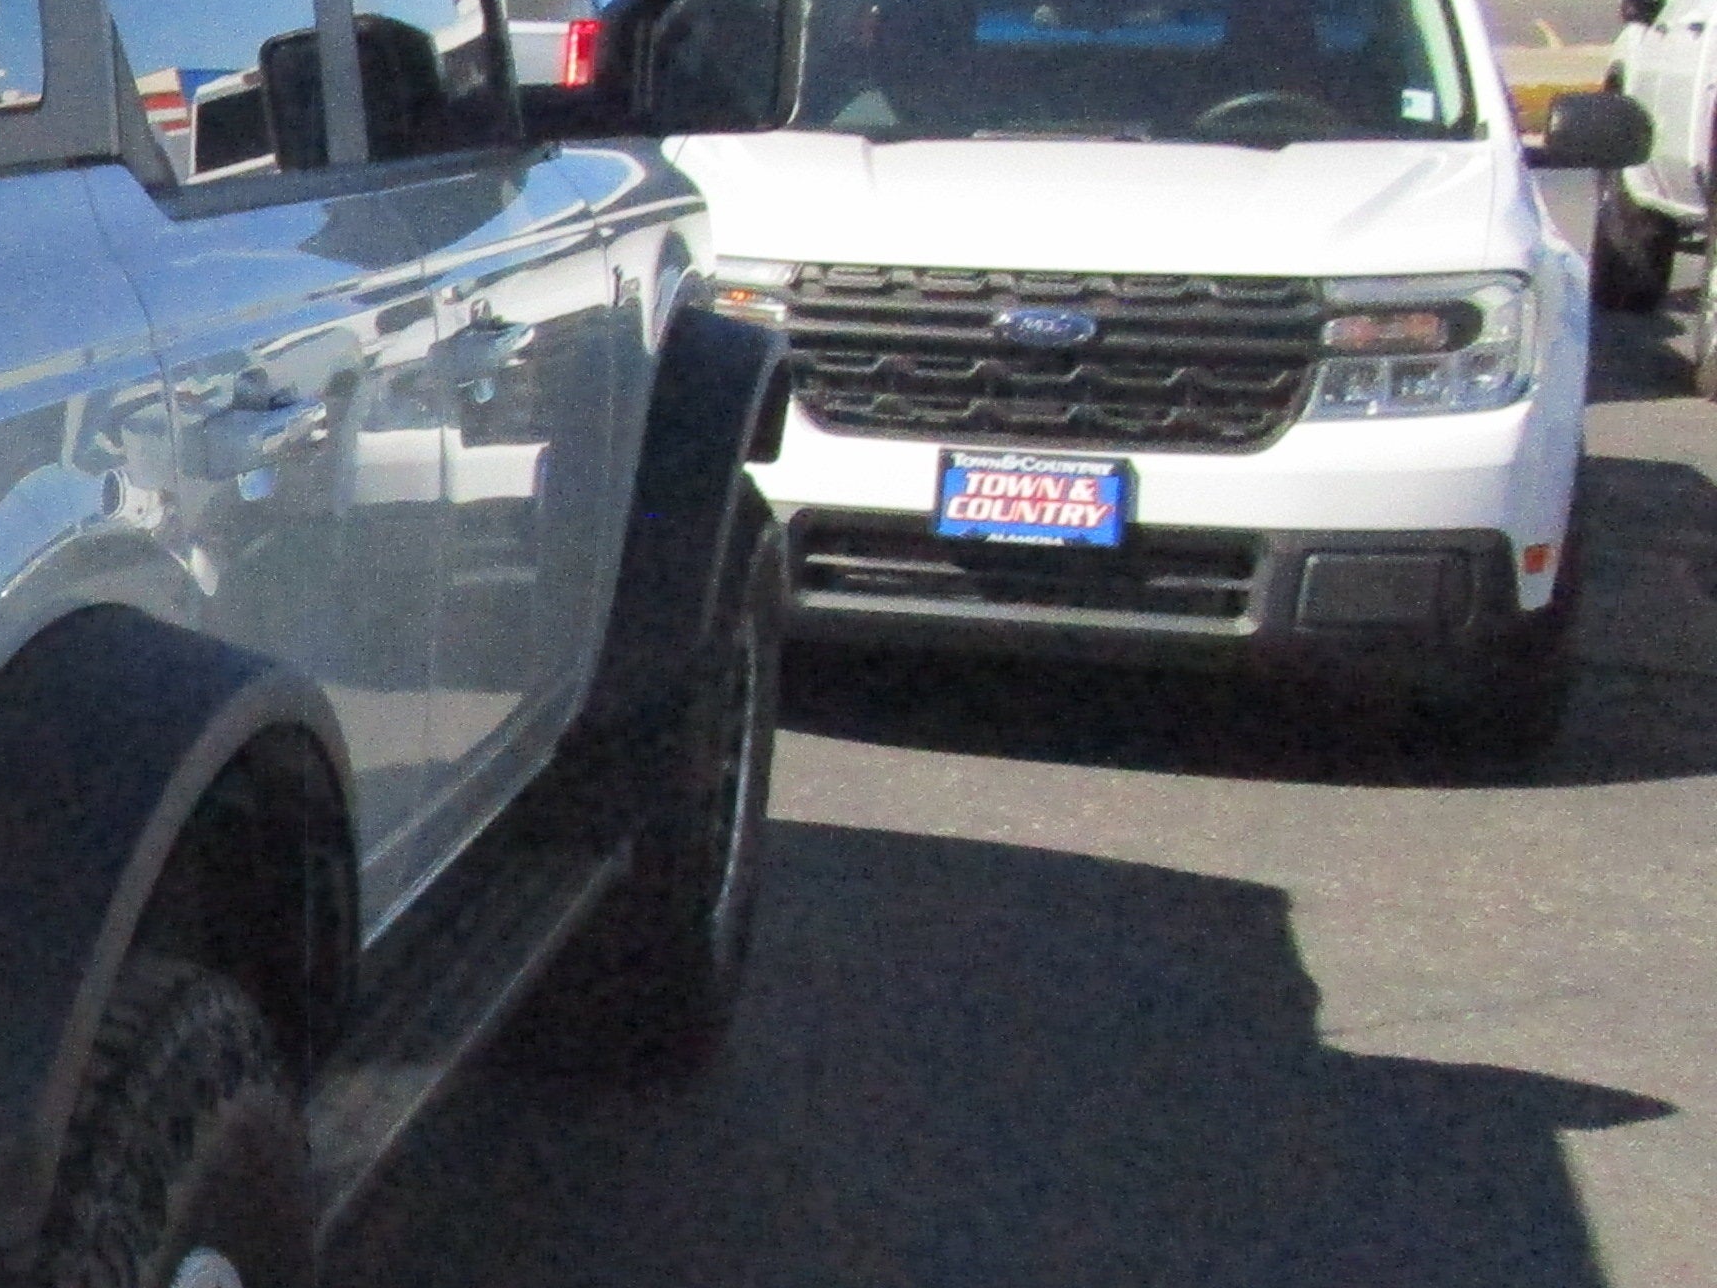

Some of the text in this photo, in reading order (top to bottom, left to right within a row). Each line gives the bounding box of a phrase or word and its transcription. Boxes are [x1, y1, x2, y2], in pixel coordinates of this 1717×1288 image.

[966, 472, 1098, 502] TOWN &
[946, 495, 1114, 528] COUNTRY
